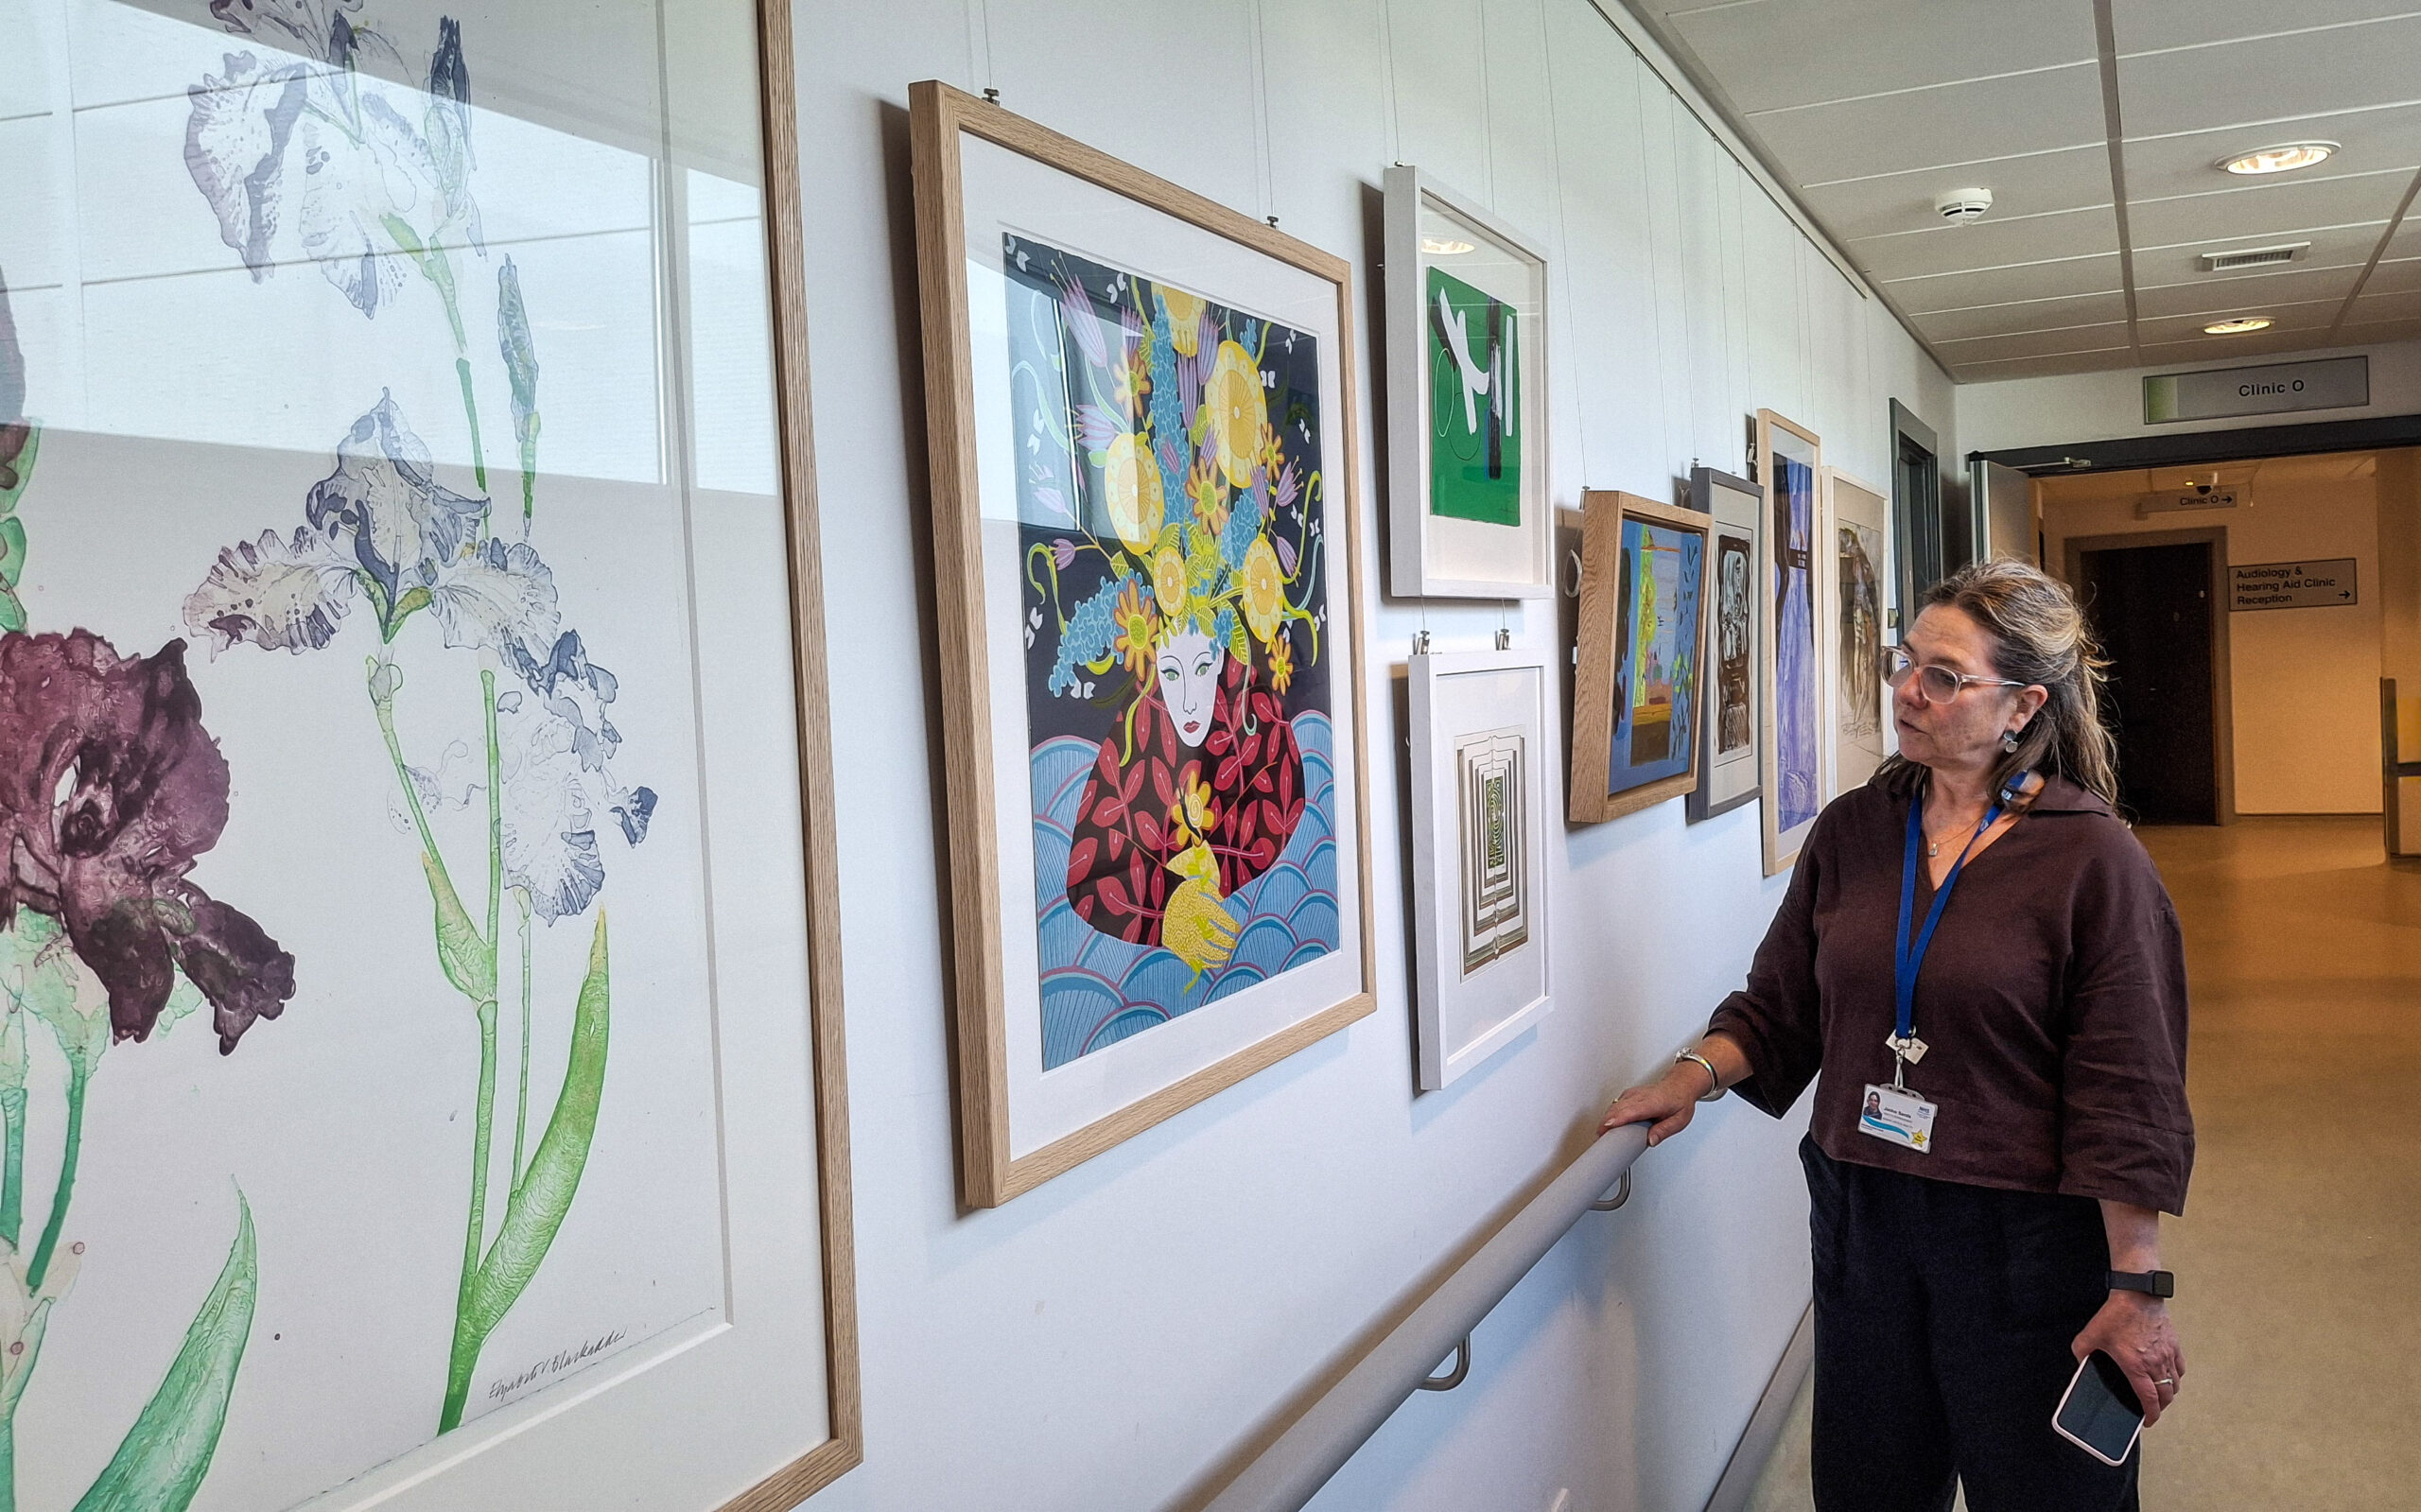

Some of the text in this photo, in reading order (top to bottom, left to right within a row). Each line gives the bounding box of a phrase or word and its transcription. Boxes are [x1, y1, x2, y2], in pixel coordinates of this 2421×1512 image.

[2238, 379, 2305, 397] Clinic O
[2180, 495, 2219, 506] Clinic O
[2237, 566, 2303, 579] Audiology &
[2237, 578, 2336, 592] Hearing Aid Clinic
[2238, 594, 2292, 605] Reception
